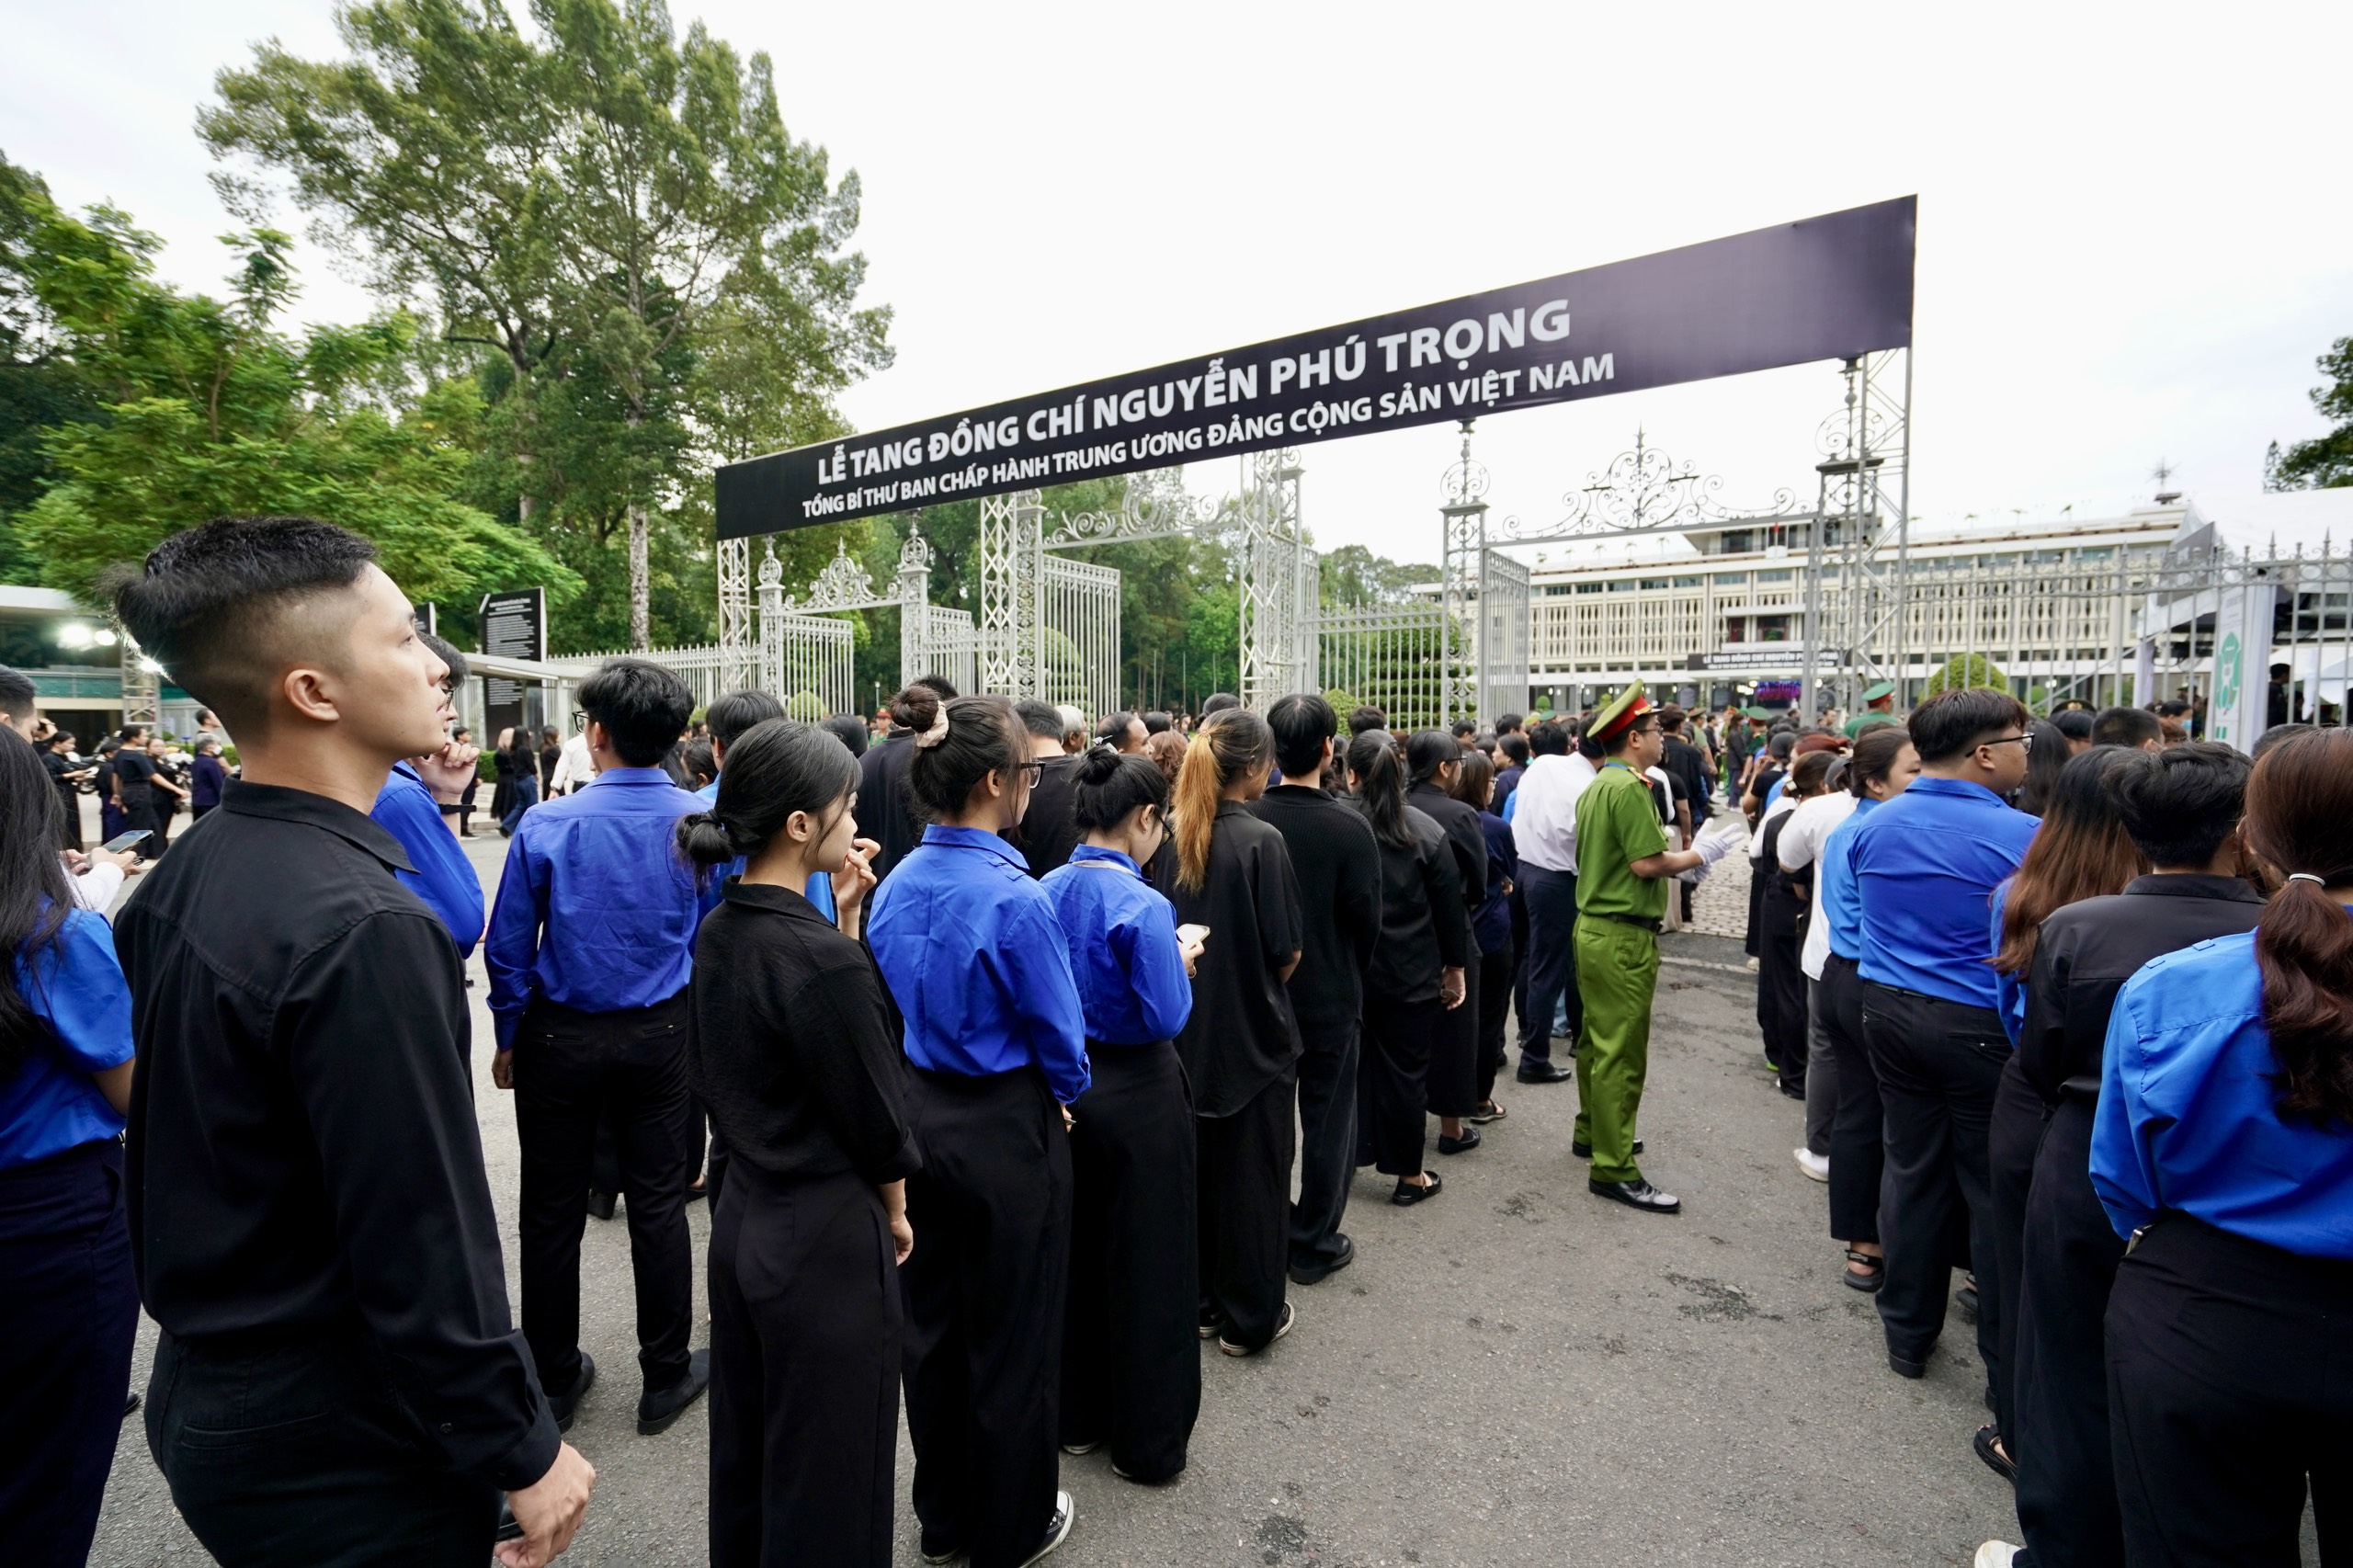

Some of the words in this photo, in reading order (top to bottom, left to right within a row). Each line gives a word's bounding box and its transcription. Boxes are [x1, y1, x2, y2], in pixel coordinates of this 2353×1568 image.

[801, 491, 845, 518] TỔNG
[847, 485, 867, 510] BÍ
[867, 481, 901, 506] THƯ
[901, 472, 937, 500] BAN
[938, 456, 989, 493] CHẤP
[992, 447, 1050, 484] HÀNH
[1051, 441, 1127, 477] TRUNG
[1131, 427, 1202, 460] ƯƠNG
[1206, 412, 1284, 447] ĐẢNG
[1290, 397, 1372, 437] CỘNG
[1379, 381, 1441, 418] SẢN
[1447, 369, 1521, 407] VIỆT
[1529, 352, 1615, 393] NAM
[817, 445, 847, 484] LỄ
[849, 437, 923, 479] TANG
[927, 416, 1019, 462] ĐỒNG
[1027, 394, 1086, 441] CHÍ
[1093, 358, 1257, 430] NGUYỄN
[1270, 335, 1366, 395] PHÚ
[1377, 298, 1571, 370] TRỌNG
